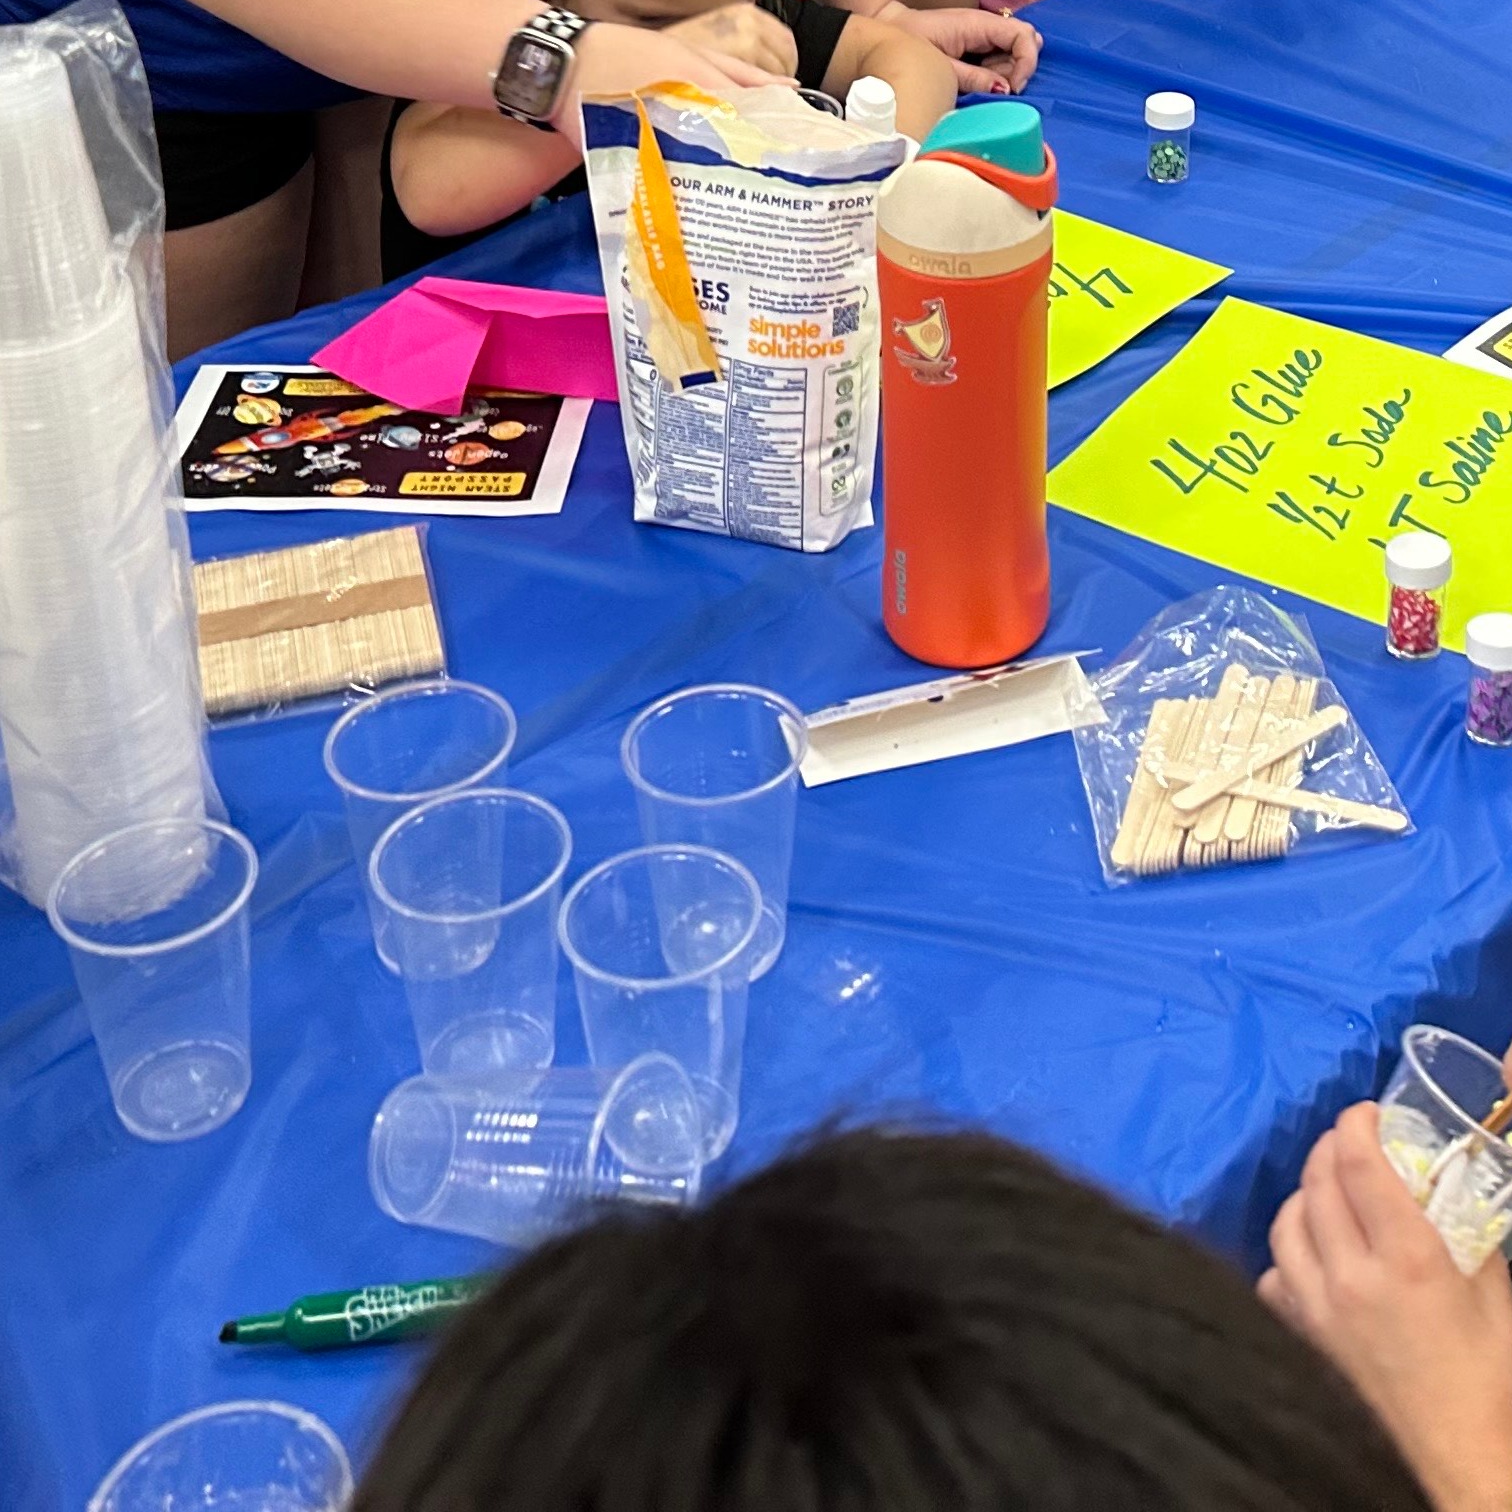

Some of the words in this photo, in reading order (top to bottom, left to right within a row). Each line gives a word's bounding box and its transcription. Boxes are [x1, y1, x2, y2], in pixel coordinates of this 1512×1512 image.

[671, 176, 701, 191] OUR
[705, 184, 735, 199] ARM
[738, 189, 746, 200] &
[828, 194, 874, 212] STORY
[749, 315, 821, 340] simple
[747, 335, 845, 360] solutions
[1231, 349, 1322, 425] Glue
[1327, 388, 1412, 469] Soda
[411, 484, 457, 492] NIGHT
[465, 484, 511, 493] STEAM
[1309, 474, 1364, 499] t
